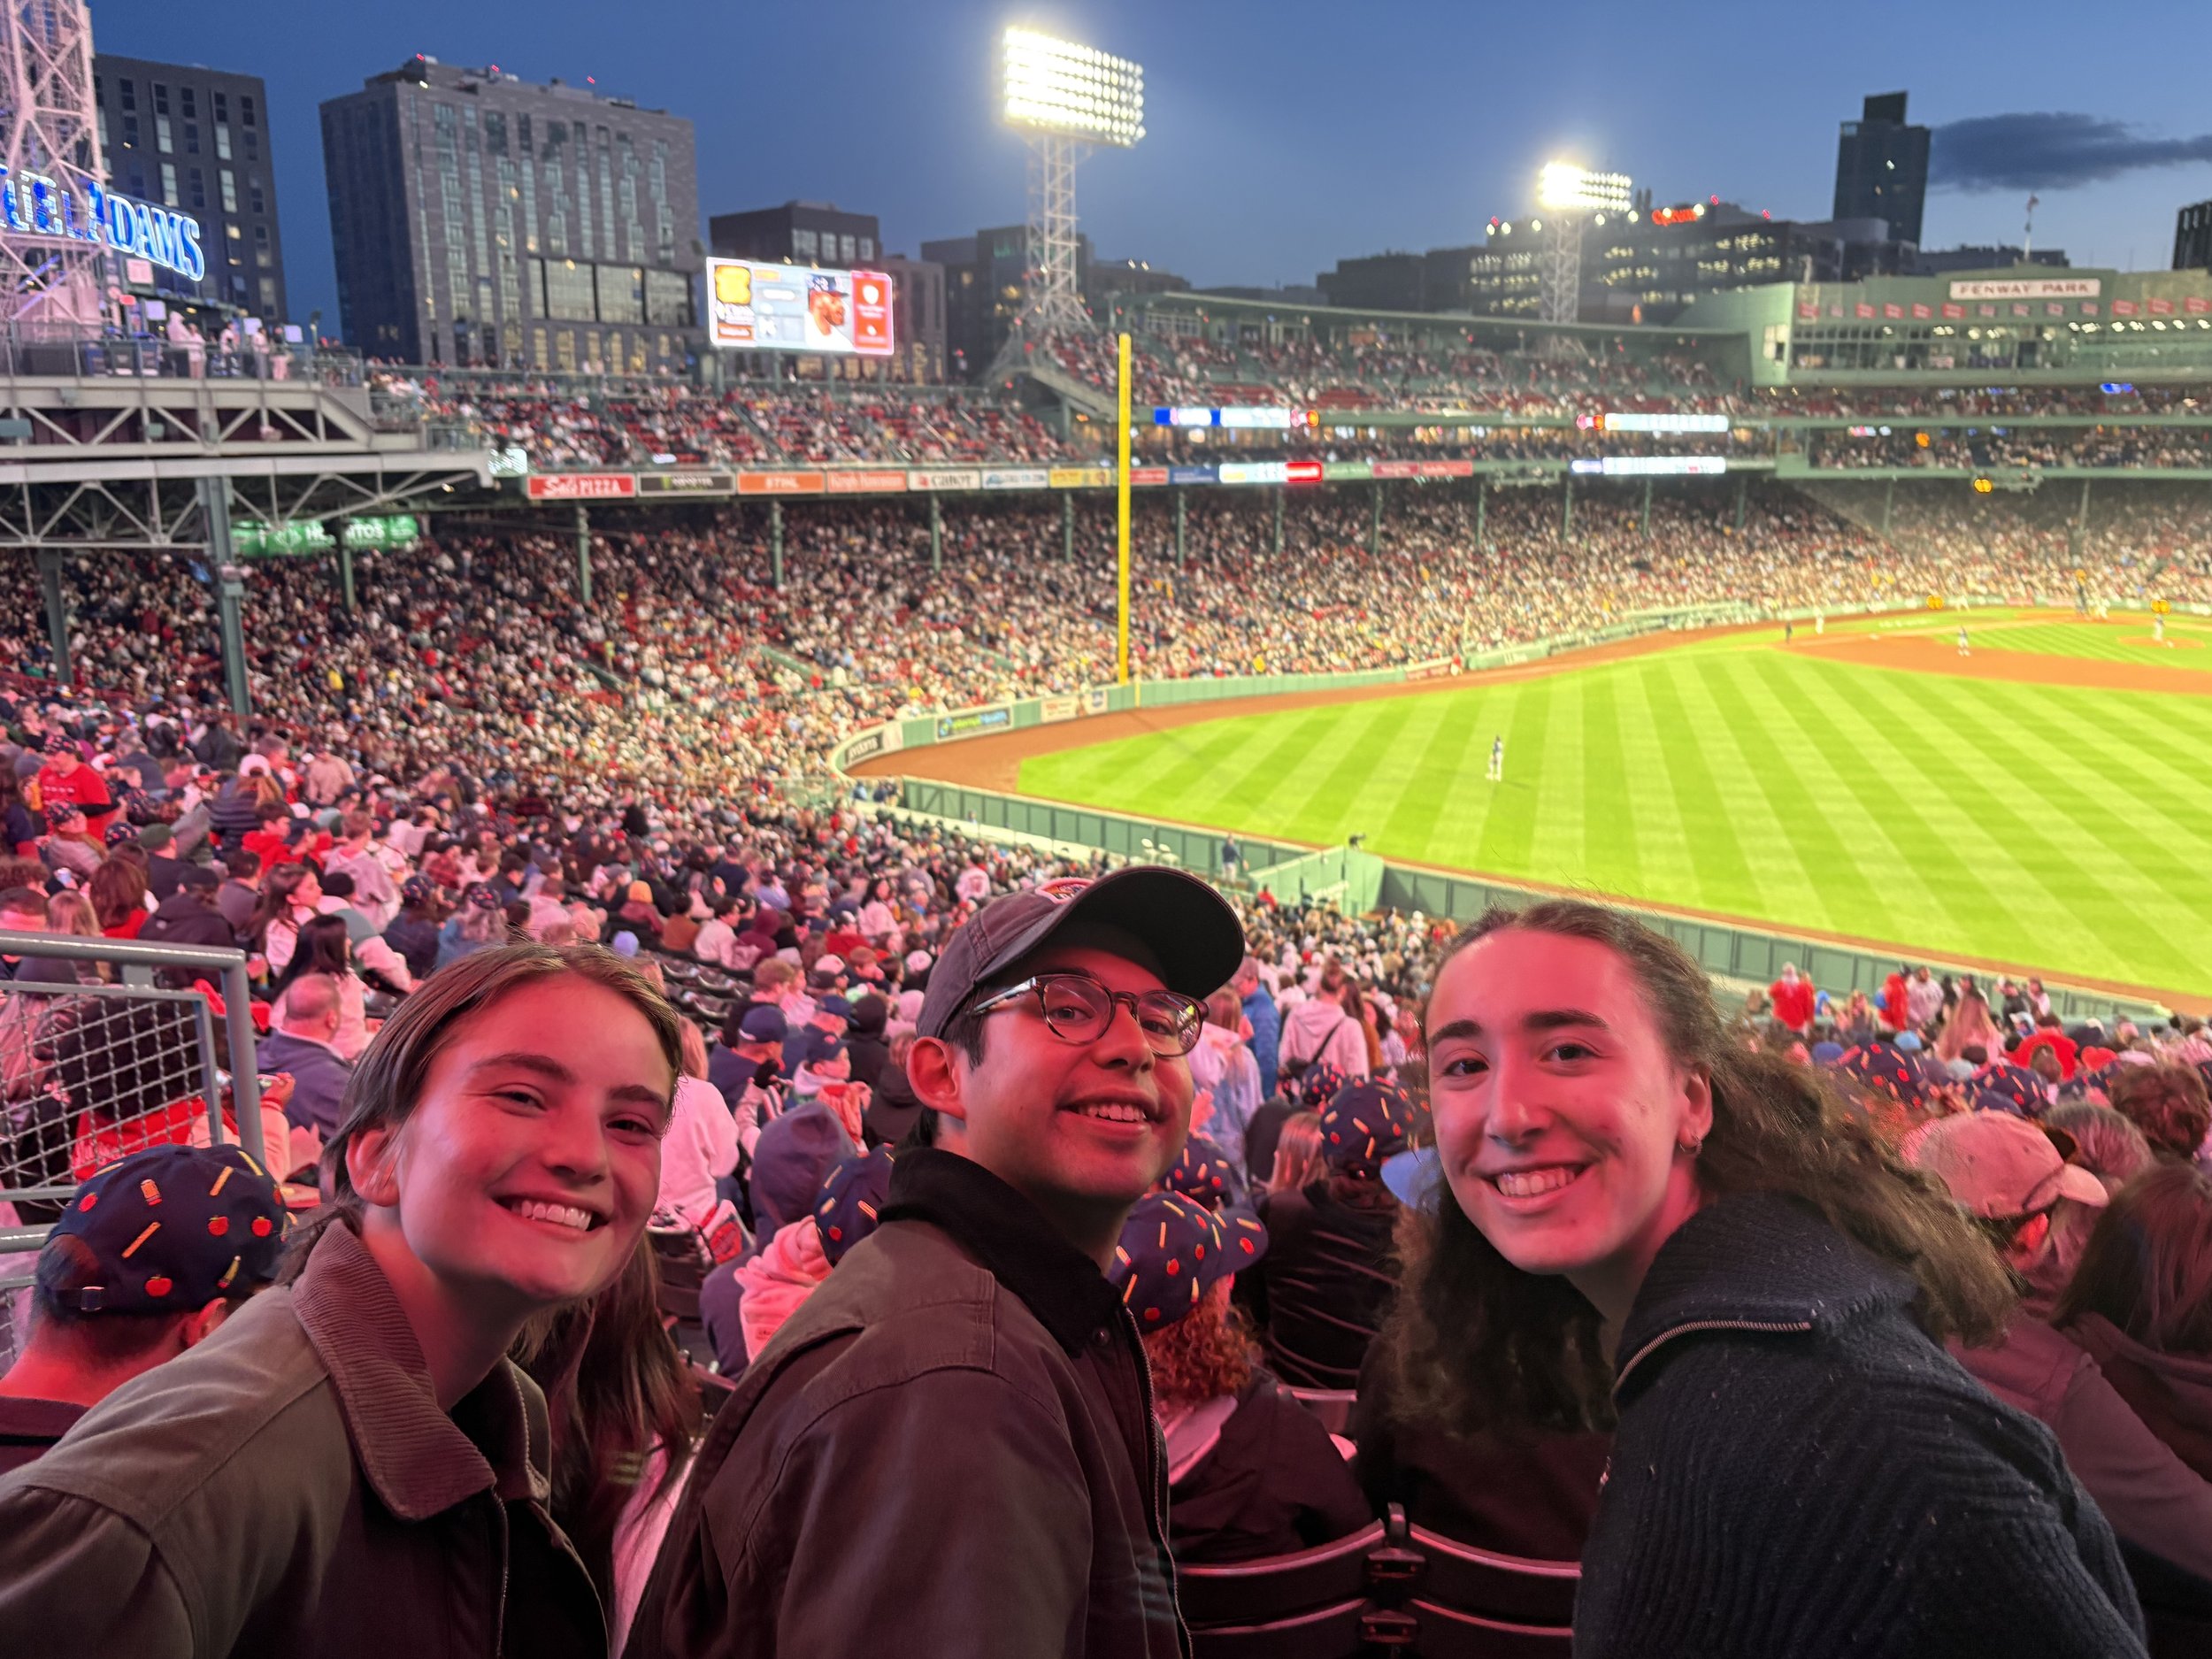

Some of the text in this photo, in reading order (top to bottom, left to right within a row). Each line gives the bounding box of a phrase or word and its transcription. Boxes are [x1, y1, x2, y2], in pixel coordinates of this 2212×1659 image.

[1959, 282, 2089, 295] FENWAY PARK
[579, 478, 622, 496] PIZZA
